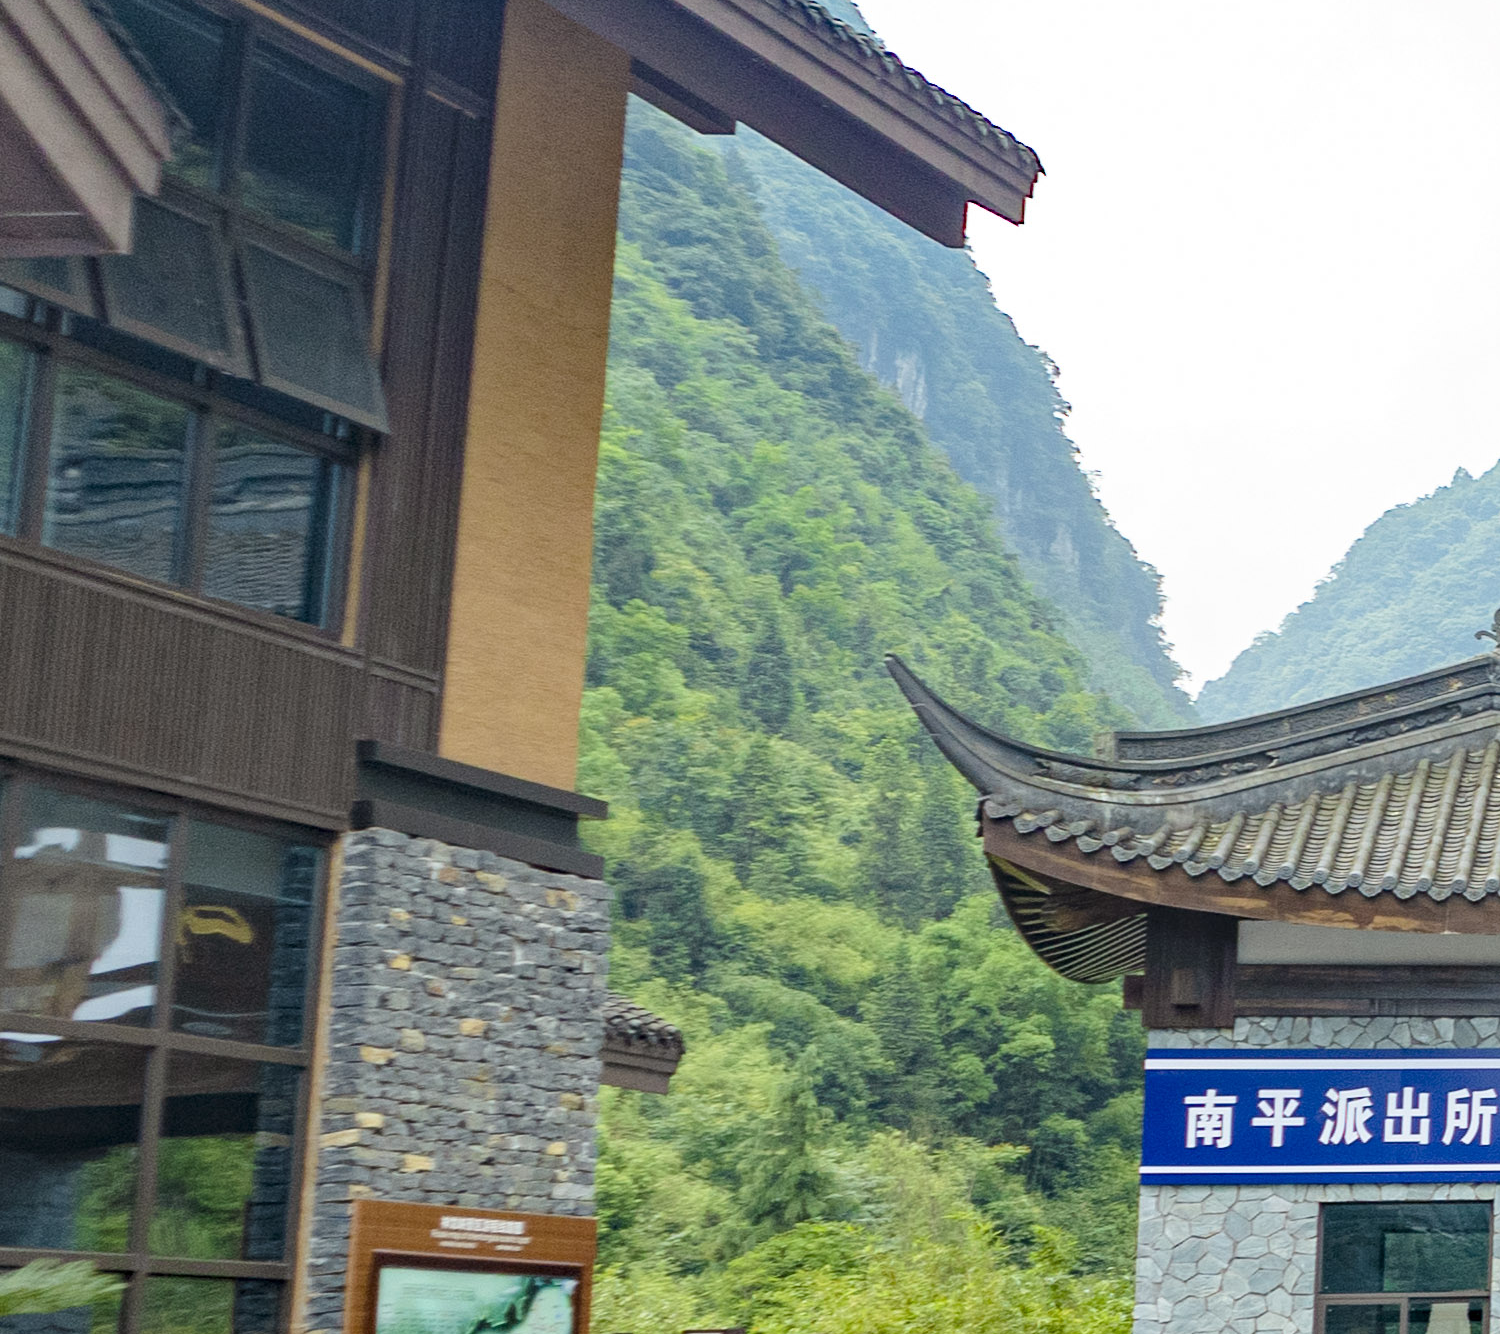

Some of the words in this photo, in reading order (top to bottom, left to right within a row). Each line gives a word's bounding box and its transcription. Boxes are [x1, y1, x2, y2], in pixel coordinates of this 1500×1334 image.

[1183, 1087, 1498, 1149] 南平派出所
